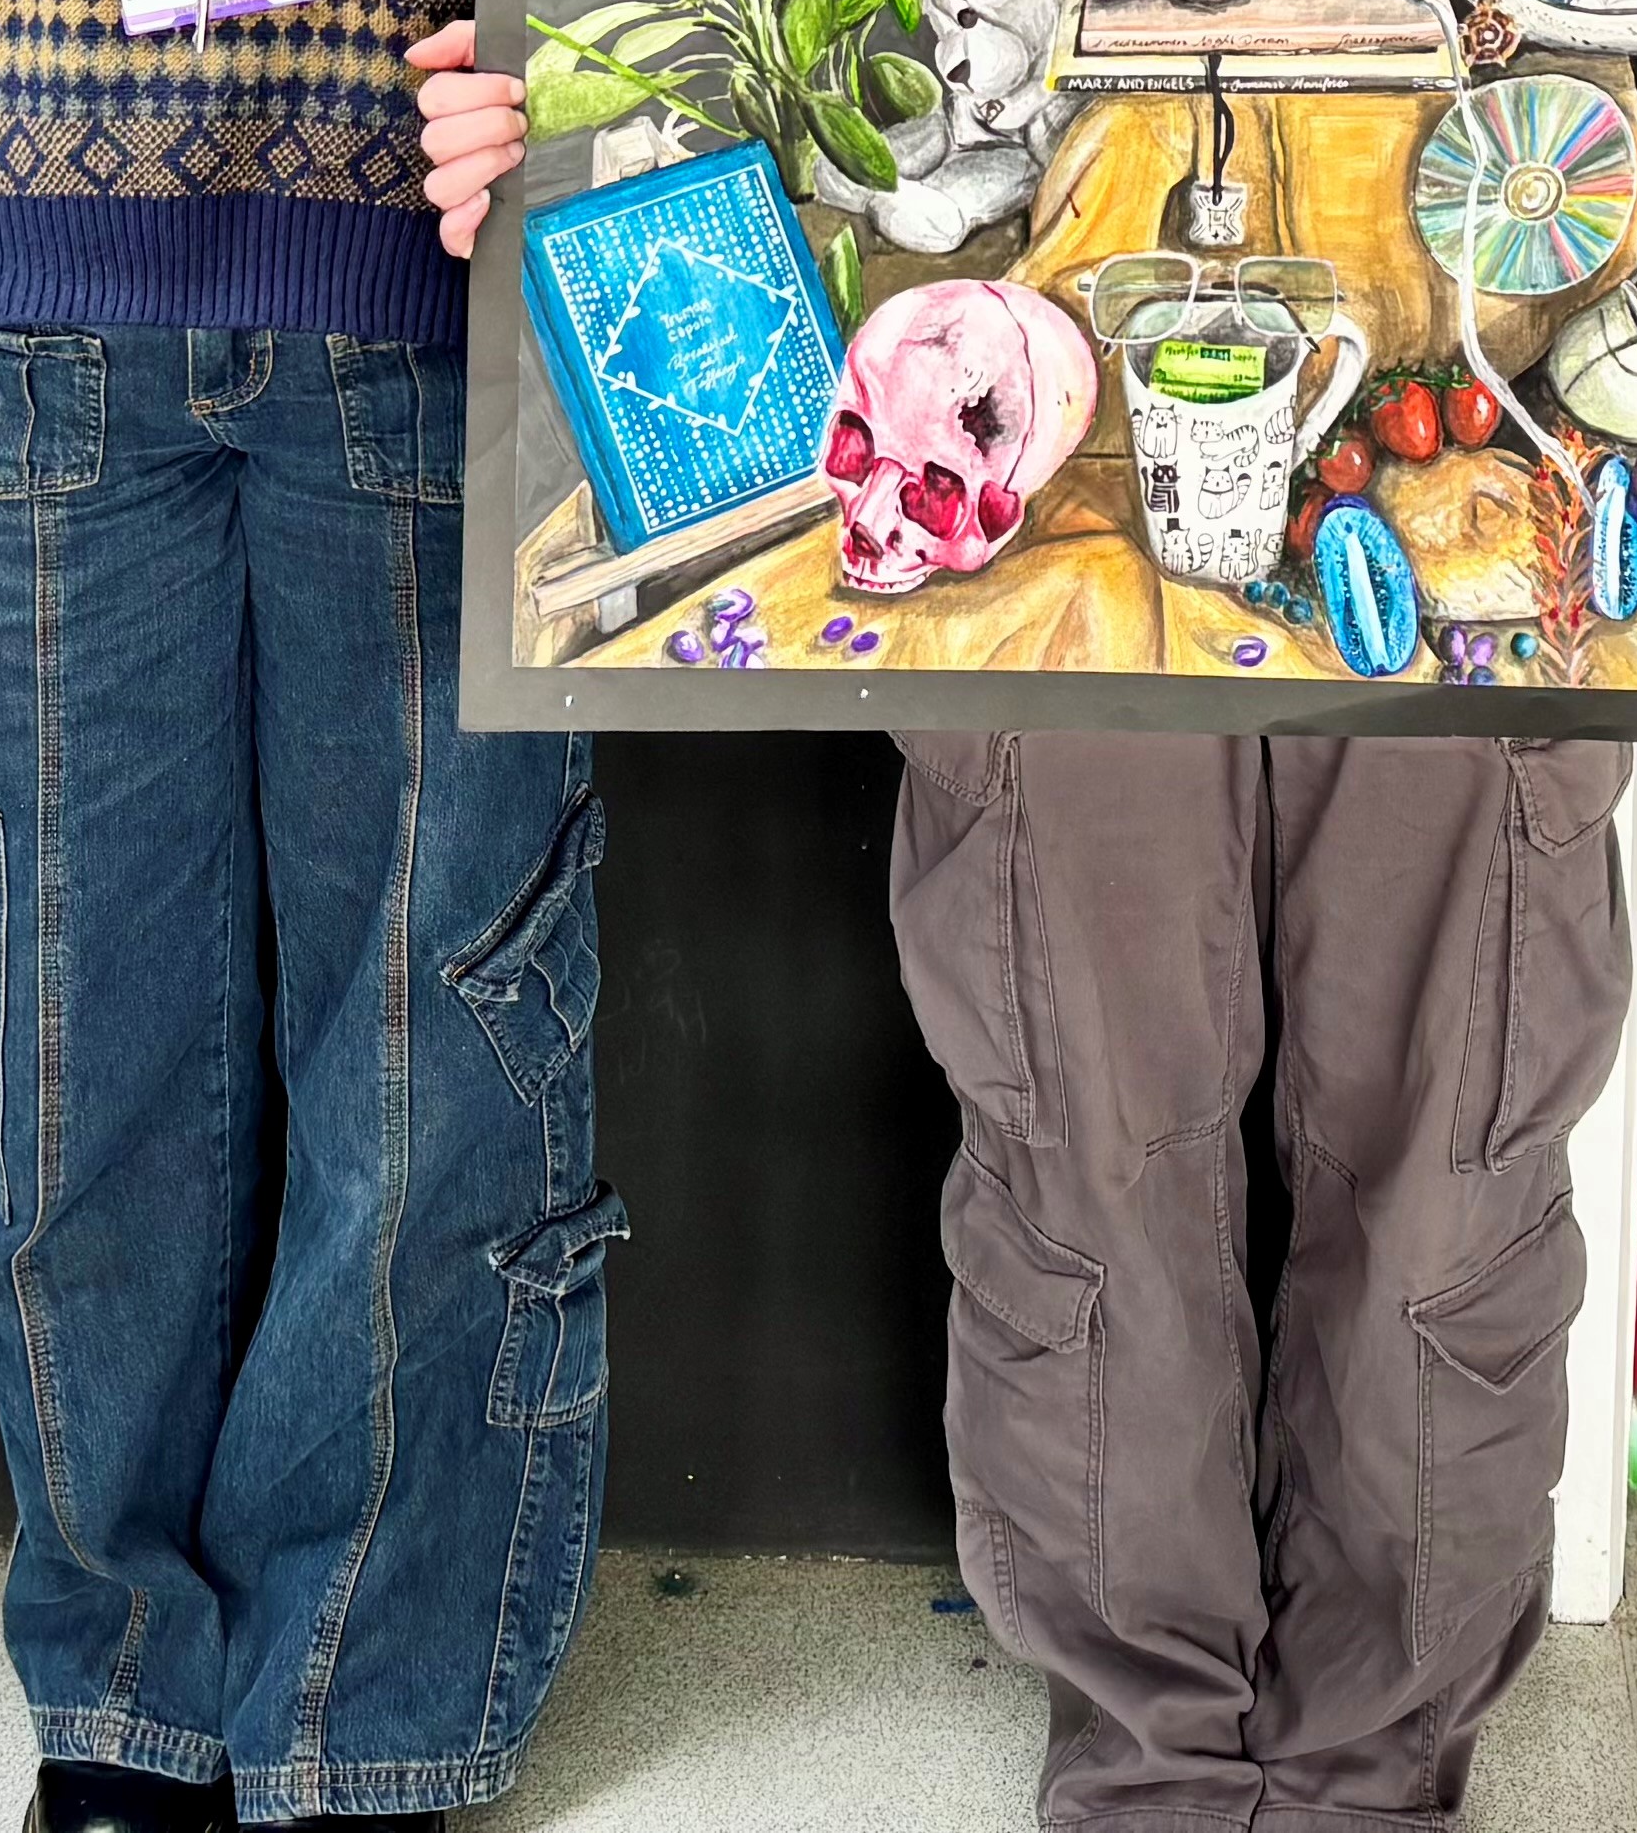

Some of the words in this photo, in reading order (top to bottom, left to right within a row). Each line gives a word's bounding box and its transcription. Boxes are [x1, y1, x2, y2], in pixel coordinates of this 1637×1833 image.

[1067, 77, 1113, 91] MARX
[1117, 77, 1144, 91] AND
[1147, 76, 1195, 91] ENGELS
